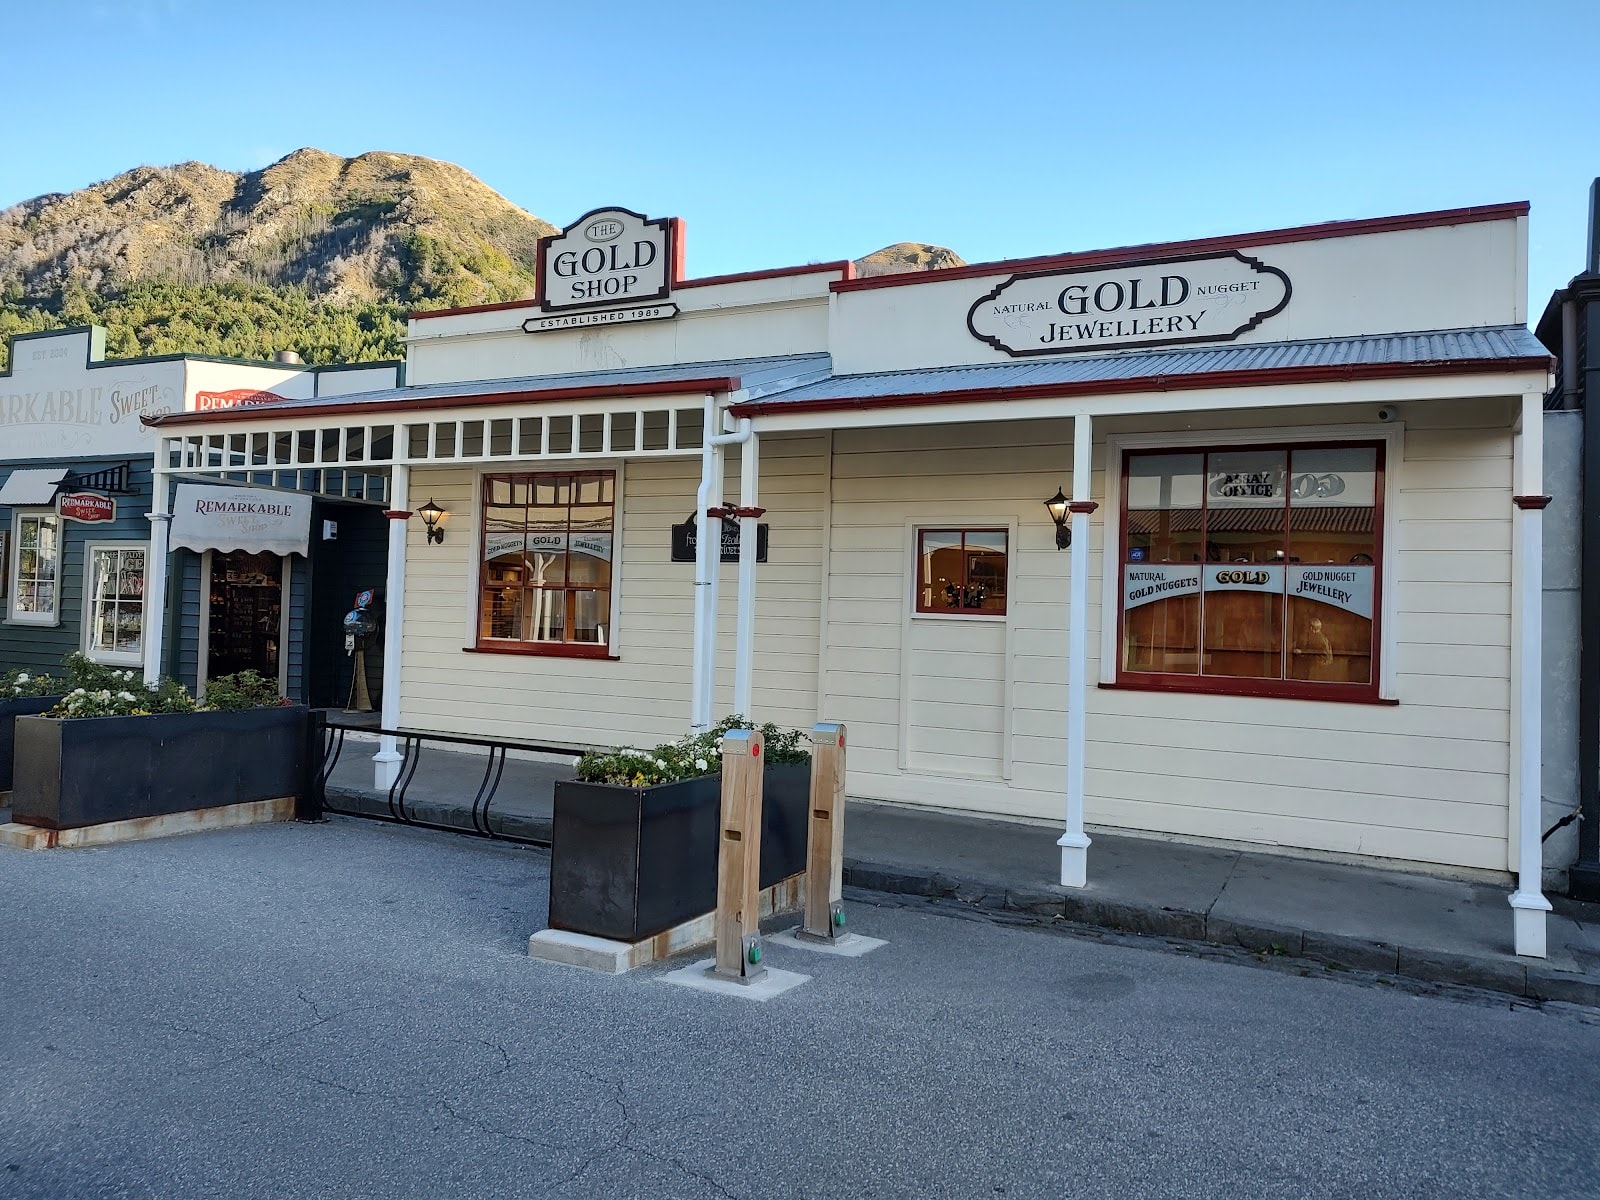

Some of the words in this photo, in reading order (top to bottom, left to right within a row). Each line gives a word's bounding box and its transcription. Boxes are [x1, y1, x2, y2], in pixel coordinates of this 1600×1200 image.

[592, 223, 616, 237] THE
[553, 240, 657, 277] GOLD
[571, 275, 638, 299] SHOP
[992, 300, 1053, 315] NATURAL
[1057, 275, 1191, 316] GOLD
[1197, 280, 1260, 296] NUGGET
[540, 312, 625, 328] ESTABLISHED
[631, 308, 660, 318] 1989
[1039, 309, 1208, 344] JEWELLERY
[110, 384, 158, 424] SWEET
[195, 499, 292, 516] REMARKABLE
[533, 536, 561, 545] GOLD
[686, 531, 697, 547] fro
[1129, 572, 1167, 582] NATURAL
[1216, 570, 1270, 585] GOLD
[1302, 571, 1323, 581] GOLD
[1324, 572, 1357, 582] NUGGET
[1129, 585, 1154, 600] GOLD
[1155, 577, 1198, 593] NUGGETS
[1295, 580, 1353, 604] JEWELLERY
